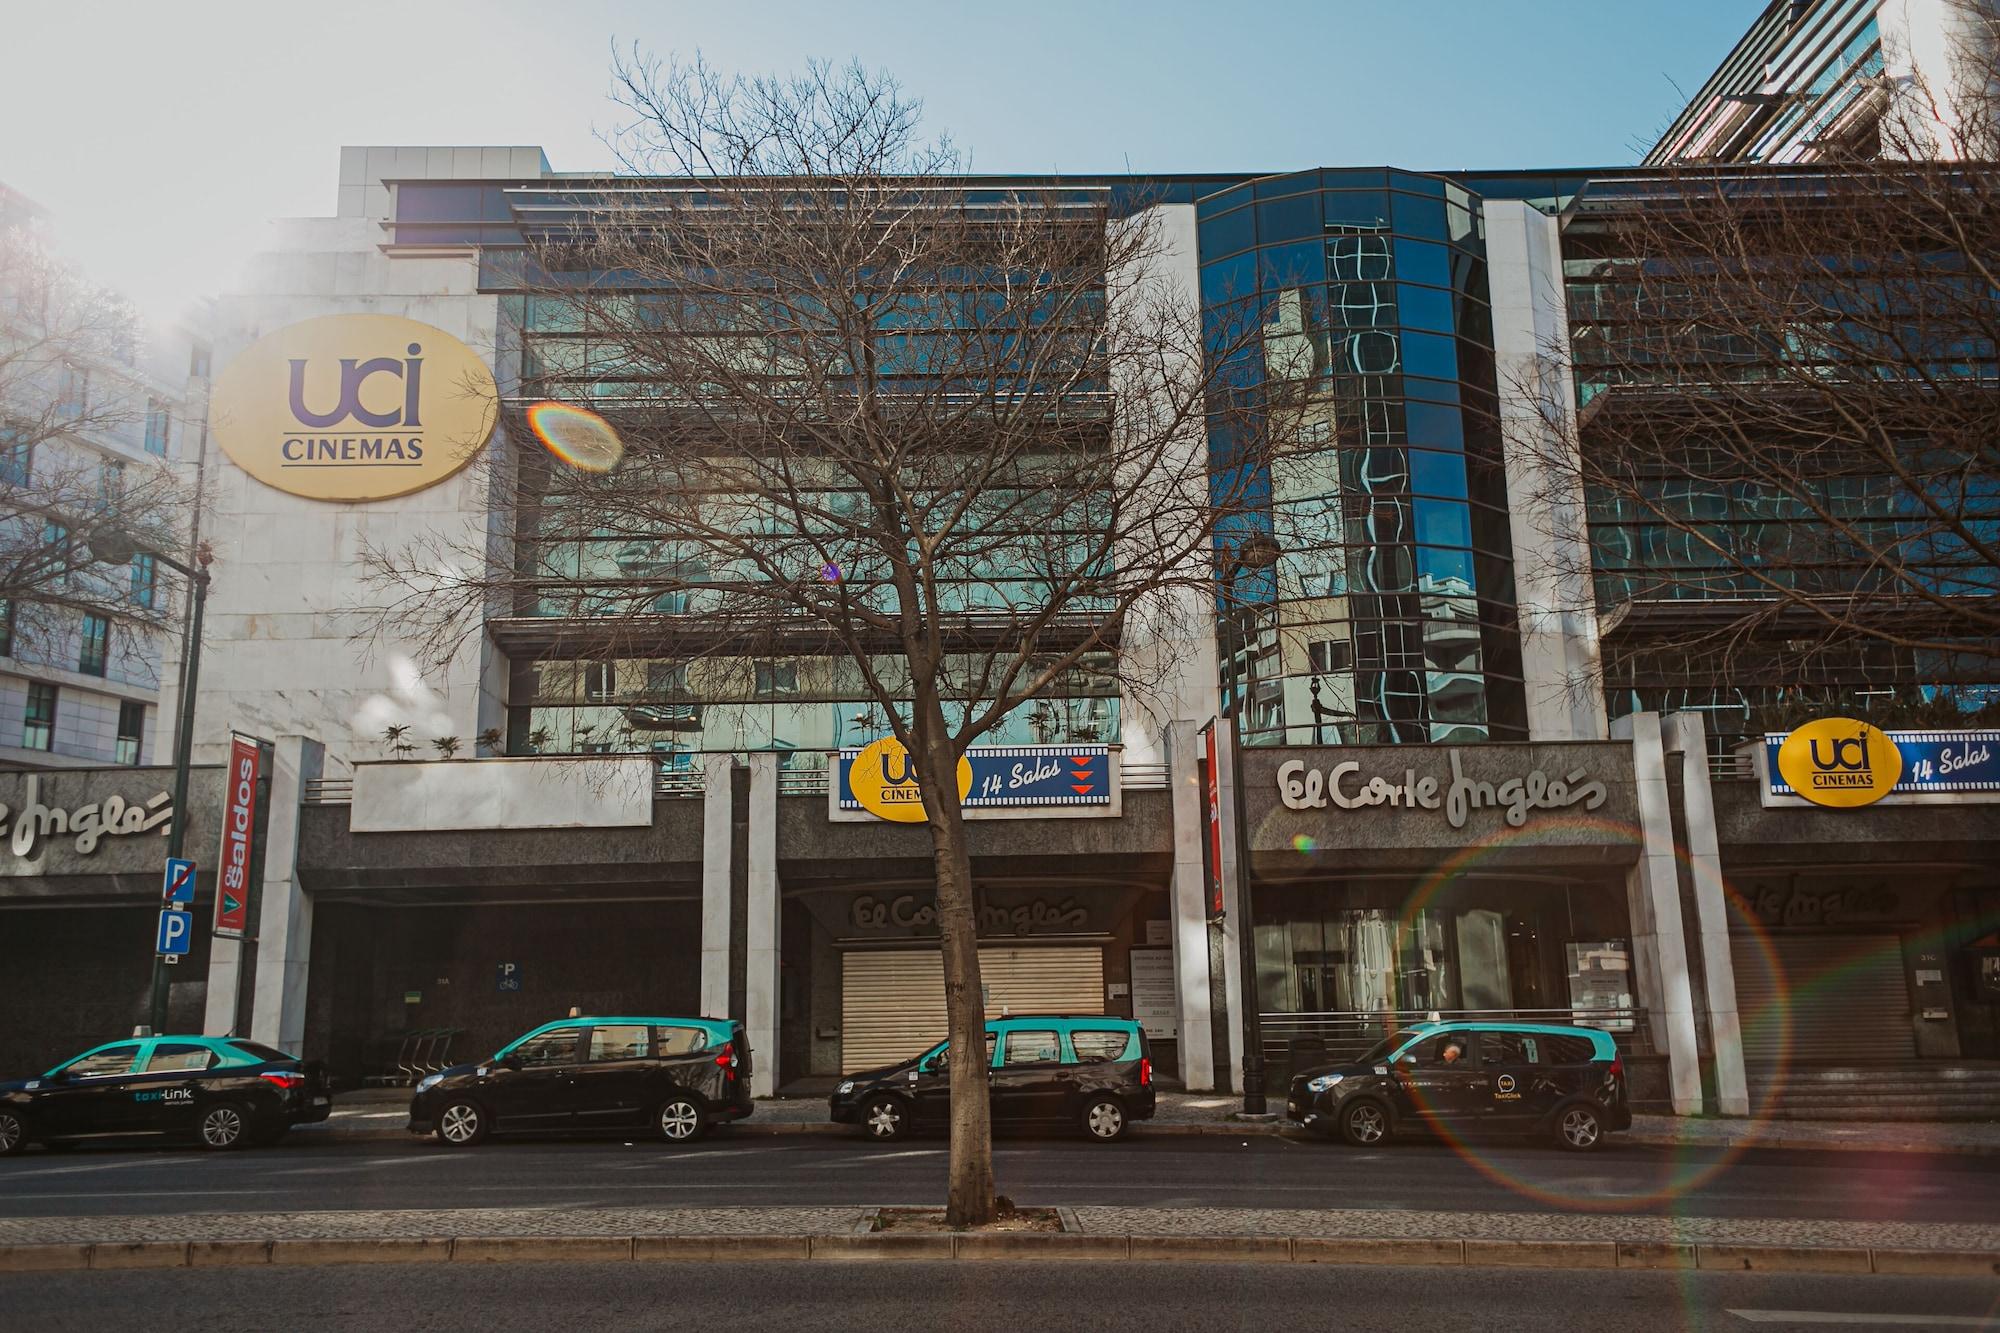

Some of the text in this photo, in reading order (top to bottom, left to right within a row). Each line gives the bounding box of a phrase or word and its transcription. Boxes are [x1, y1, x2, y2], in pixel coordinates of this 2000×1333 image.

[281, 438, 423, 460] CINEMAS
[982, 757, 1061, 798] 14 Salas
[1813, 774, 1873, 785] CINEMAS
[1912, 743, 1990, 783] 14 Salas
[1277, 749, 1607, 828] El Corte Inglés
[231, 758, 253, 889] saldos
[171, 864, 189, 895] P
[853, 895, 888, 929] El
[165, 915, 185, 949] P
[504, 963, 516, 976] P
